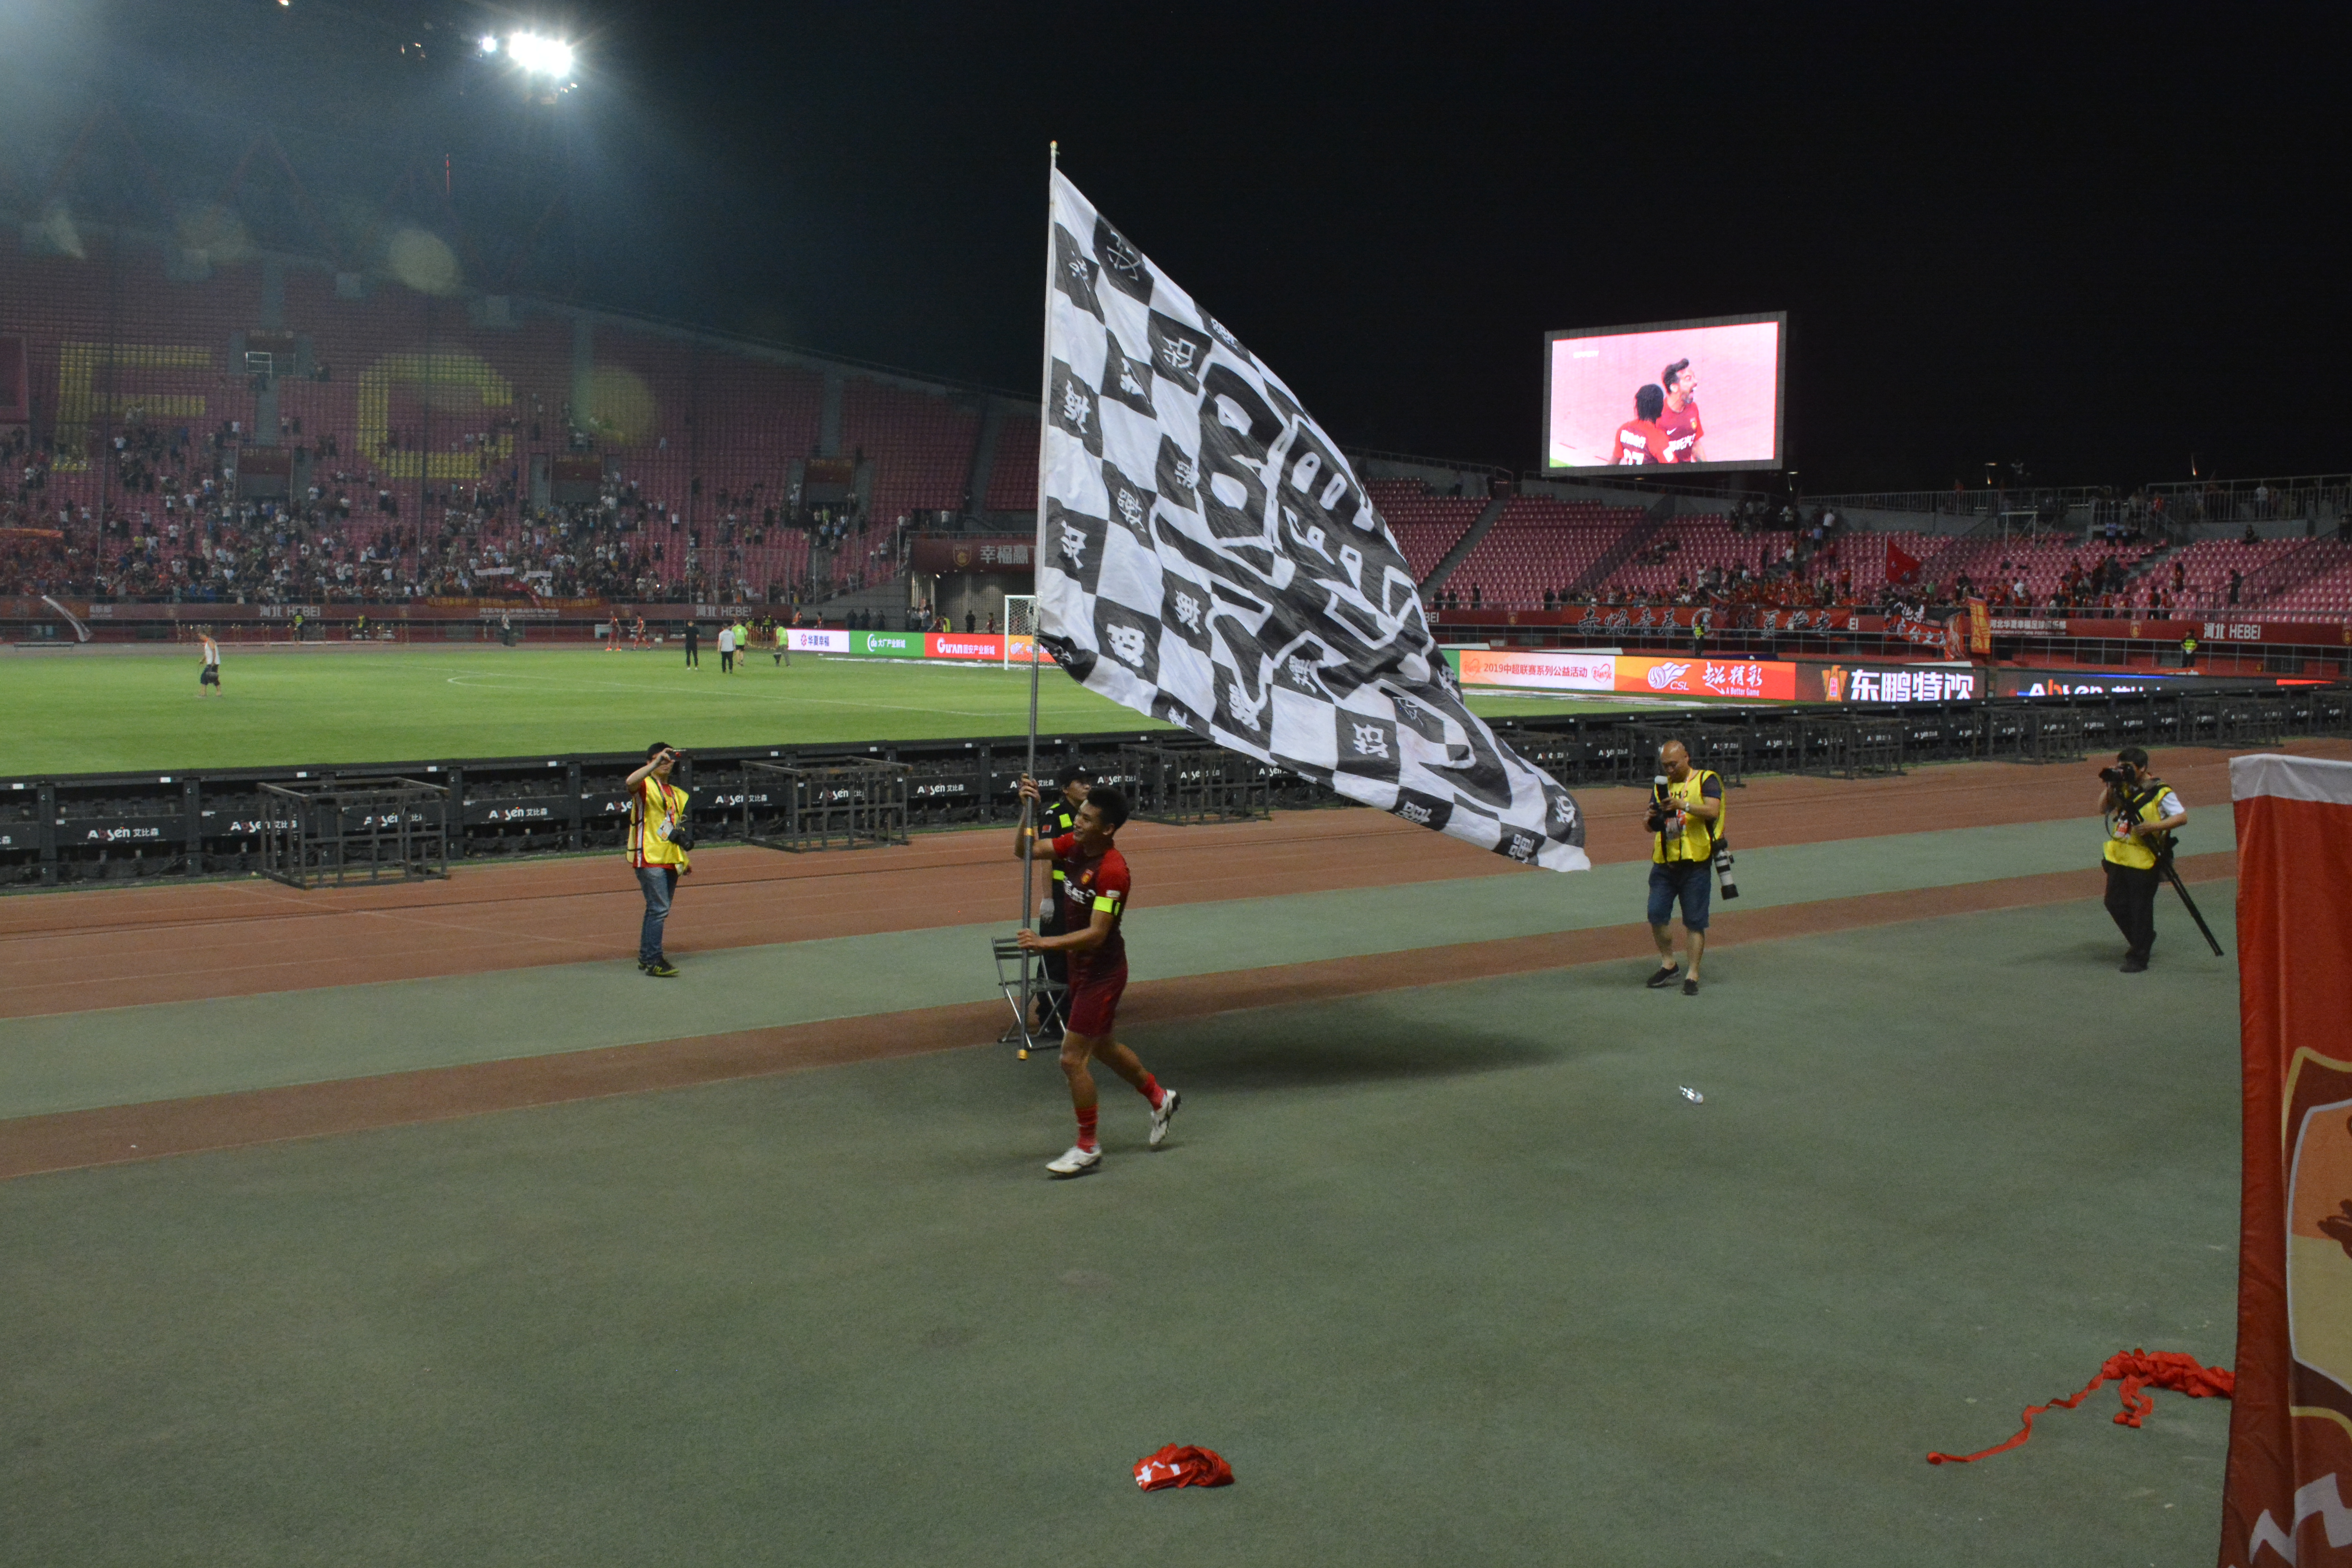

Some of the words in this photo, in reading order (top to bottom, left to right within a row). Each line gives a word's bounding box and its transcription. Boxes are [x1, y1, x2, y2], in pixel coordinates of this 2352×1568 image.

[2203, 622, 2225, 639] 河北
[2229, 624, 2261, 640] HEBEI
[808, 635, 829, 646] 华夏幸福
[1483, 663, 1588, 678] 2019中超联赛系列公益活动
[1670, 681, 1690, 691] CSL
[1851, 669, 1974, 702] 东鹏特饮
[1746, 688, 1760, 697] Game
[606, 800, 633, 813] Abse
[488, 809, 524, 821] Absen
[526, 808, 548, 817] 艾比森
[87, 828, 131, 842] Absen
[133, 828, 160, 837] 艾比森
